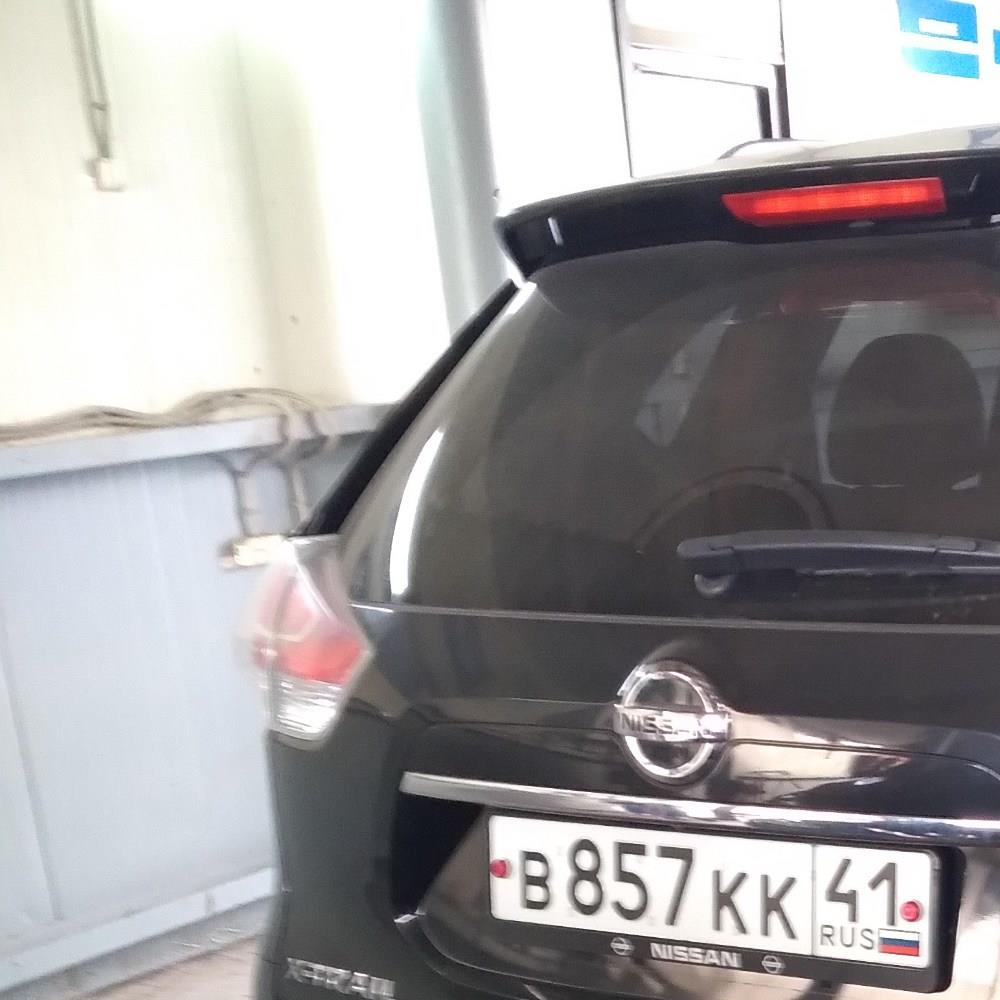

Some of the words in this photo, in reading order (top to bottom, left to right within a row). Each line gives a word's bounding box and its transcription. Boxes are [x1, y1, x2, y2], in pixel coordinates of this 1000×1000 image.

[824, 858, 898, 926] 41
[820, 925, 875, 950] RUS
[649, 943, 742, 969] NISSAN
